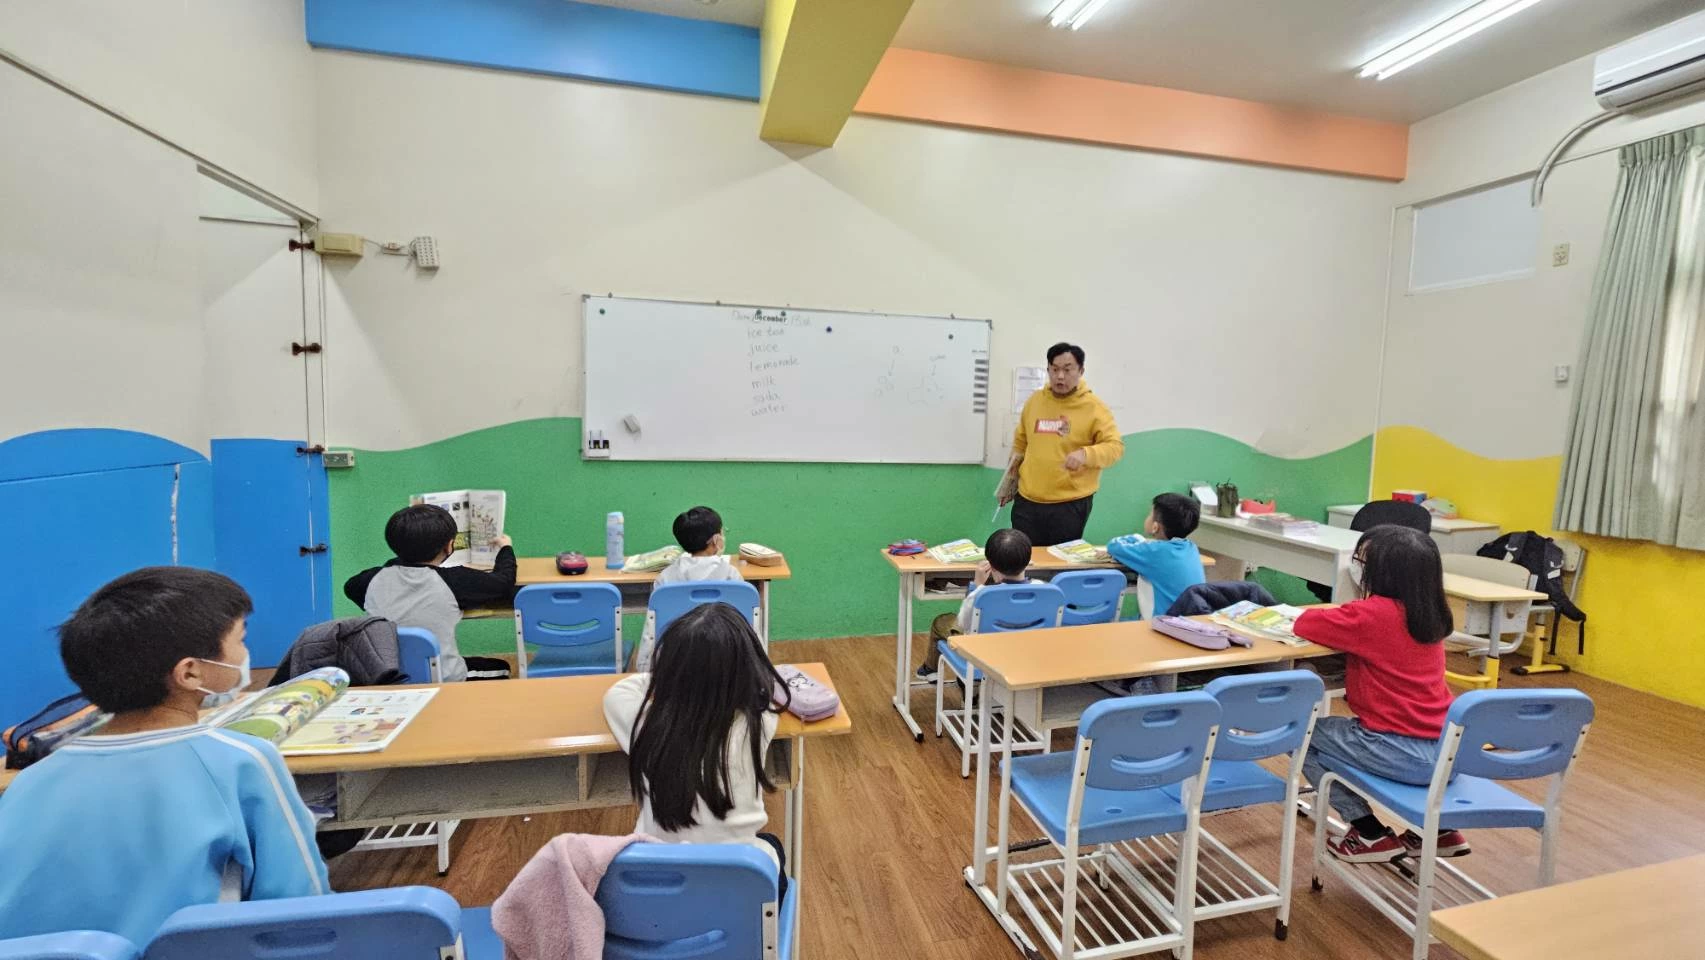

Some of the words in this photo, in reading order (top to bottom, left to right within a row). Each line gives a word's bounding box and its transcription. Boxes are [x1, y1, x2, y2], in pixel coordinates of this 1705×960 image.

[749, 343, 780, 355] juice
[751, 375, 776, 389] milk
[751, 403, 785, 417] water
